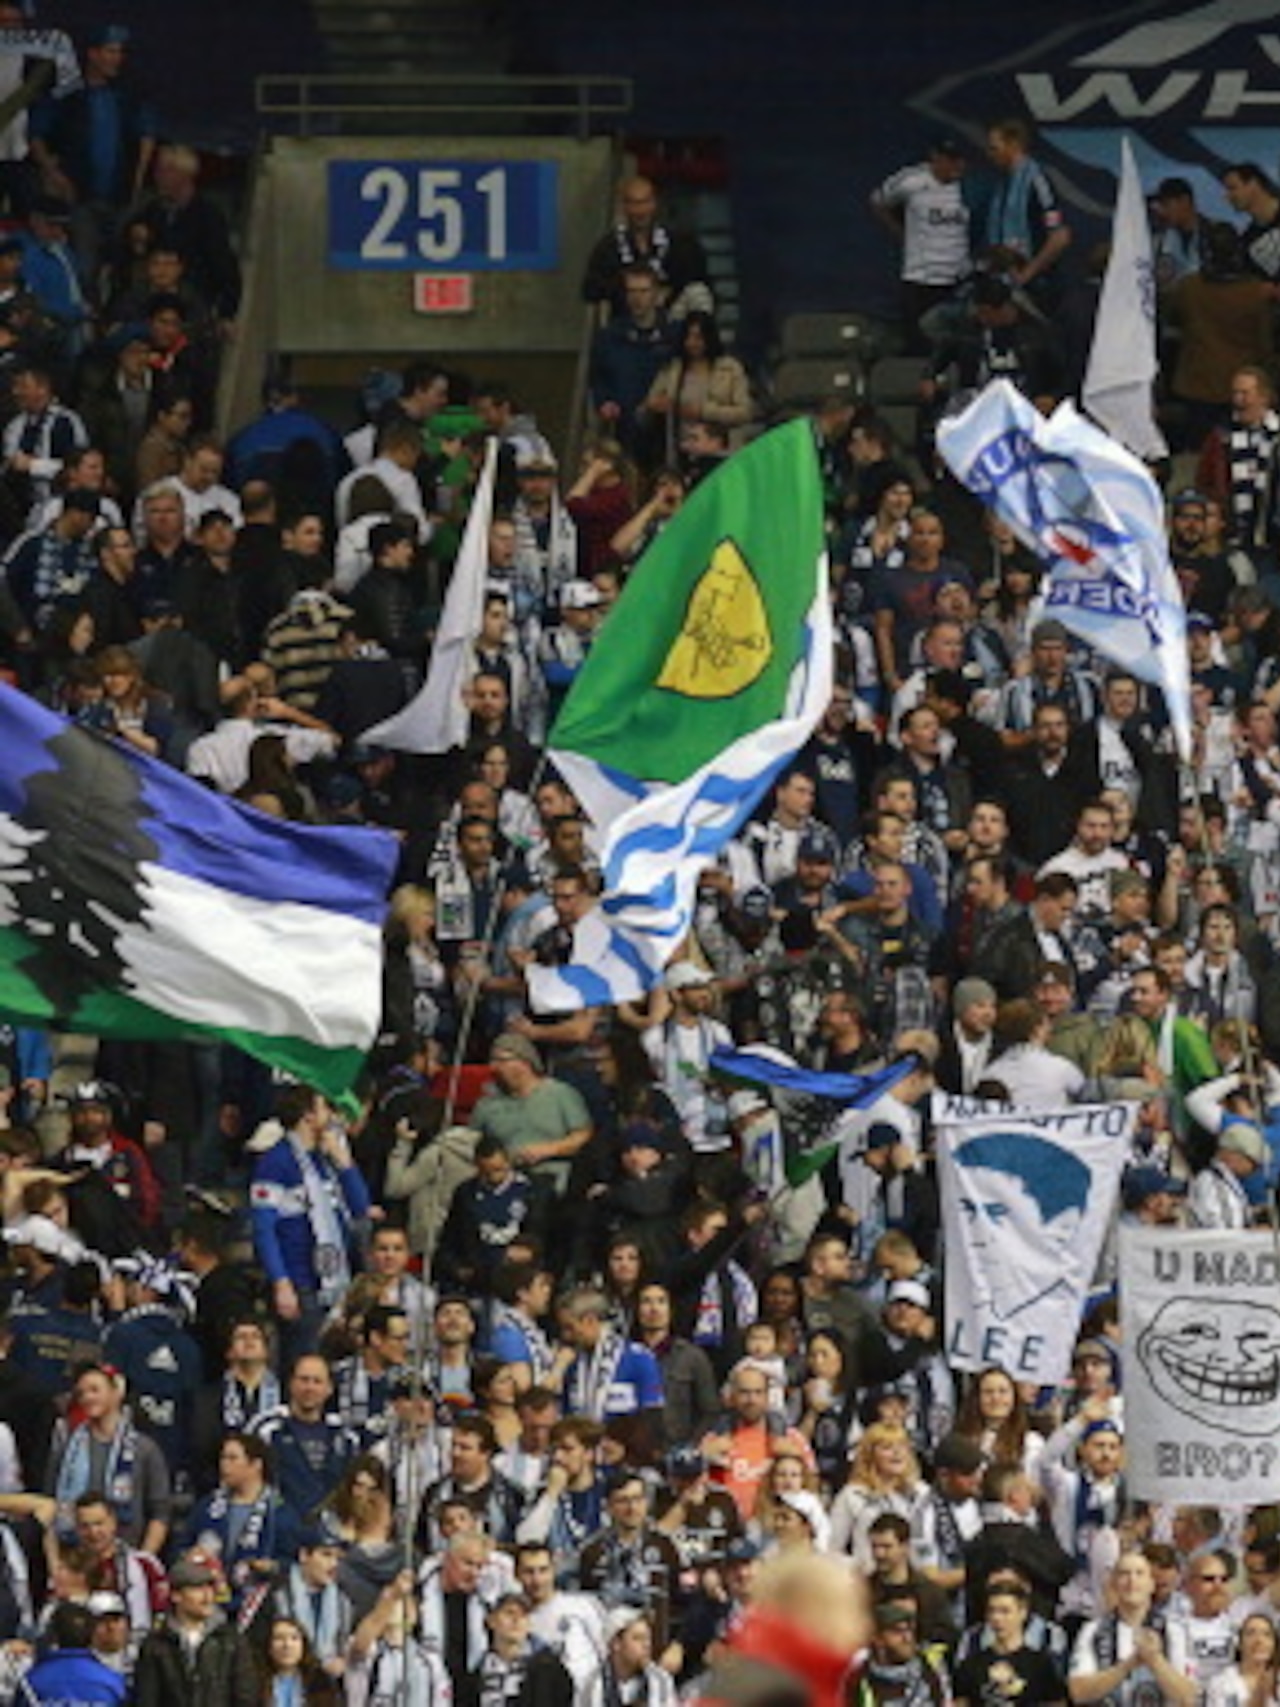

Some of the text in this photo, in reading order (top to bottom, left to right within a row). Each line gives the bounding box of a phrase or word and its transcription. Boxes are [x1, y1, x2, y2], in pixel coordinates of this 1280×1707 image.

[360, 166, 507, 262] 251
[1153, 1249, 1180, 1283] U
[950, 1317, 1046, 1372] LEE
[1155, 1440, 1278, 1481] BRO?
